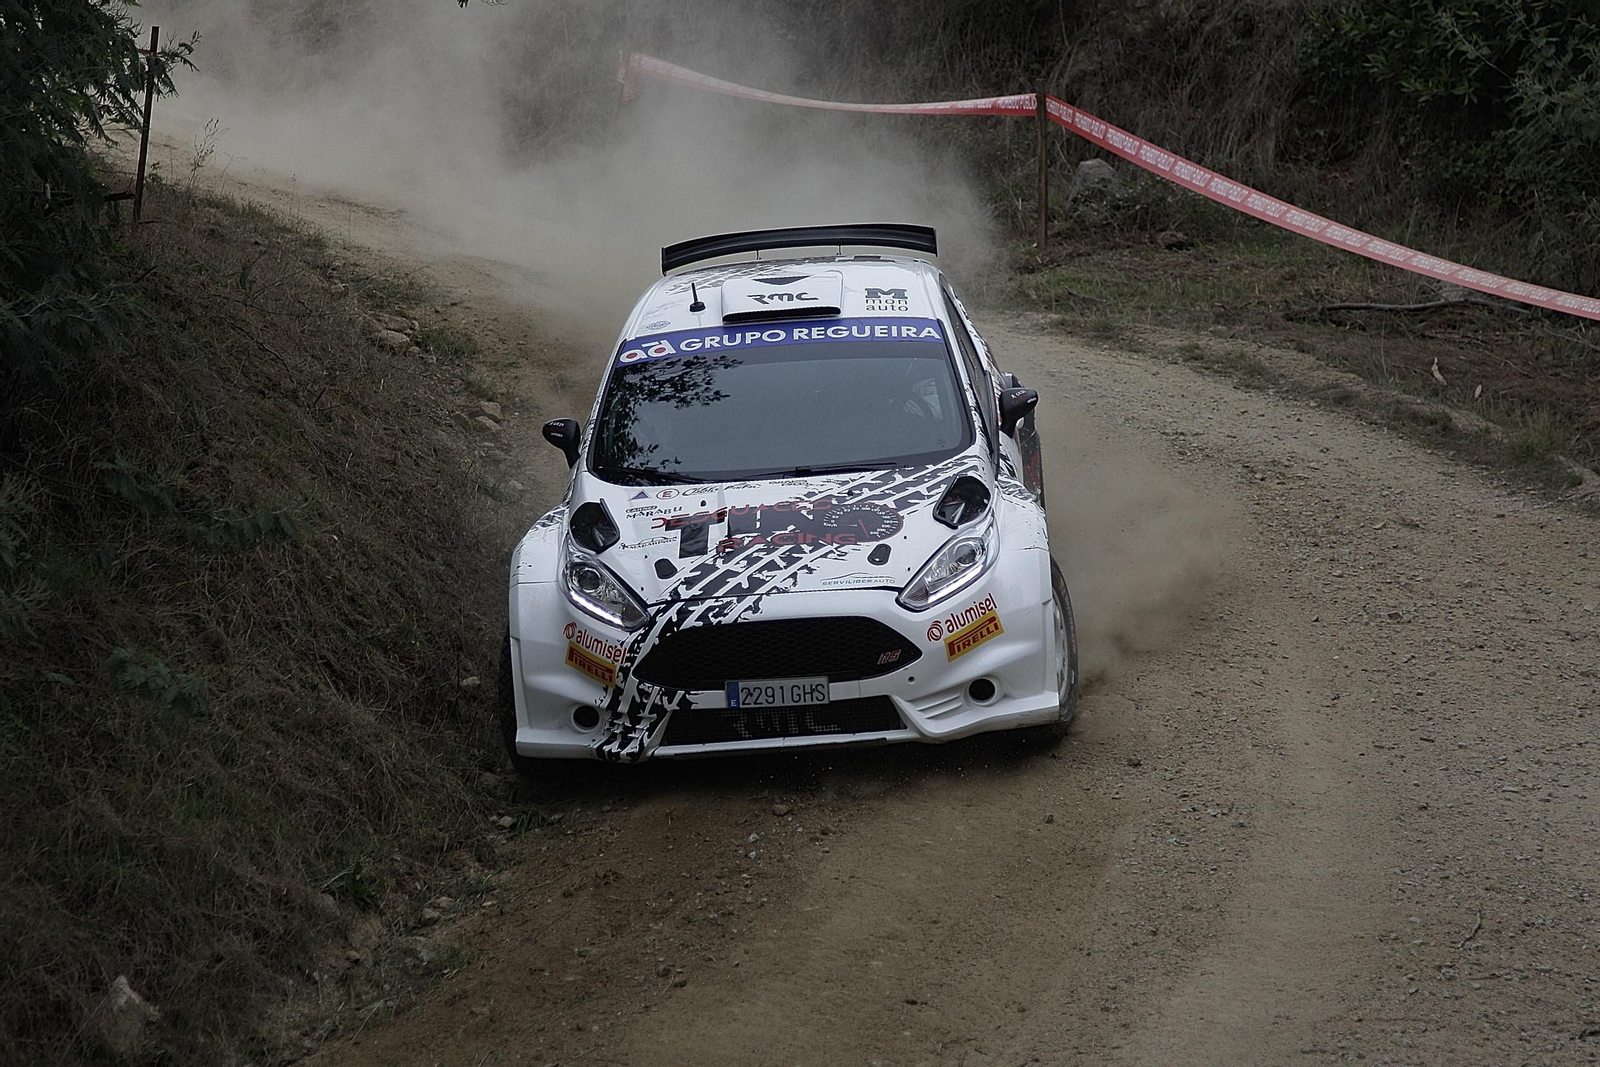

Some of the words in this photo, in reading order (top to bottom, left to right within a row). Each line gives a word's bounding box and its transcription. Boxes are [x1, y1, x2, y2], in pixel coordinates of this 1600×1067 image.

[864, 288, 909, 300] M
[866, 304, 909, 312] auto
[679, 329, 786, 351] GRUPO
[793, 325, 941, 341] REGUEIRA
[716, 532, 856, 555] RACING
[944, 592, 998, 633] alumisel
[575, 628, 627, 665] alumisel
[947, 616, 1000, 657] PIRELLI
[567, 646, 614, 683] PIRELLI
[731, 699, 738, 708] E
[740, 683, 827, 706] 2291GHS
